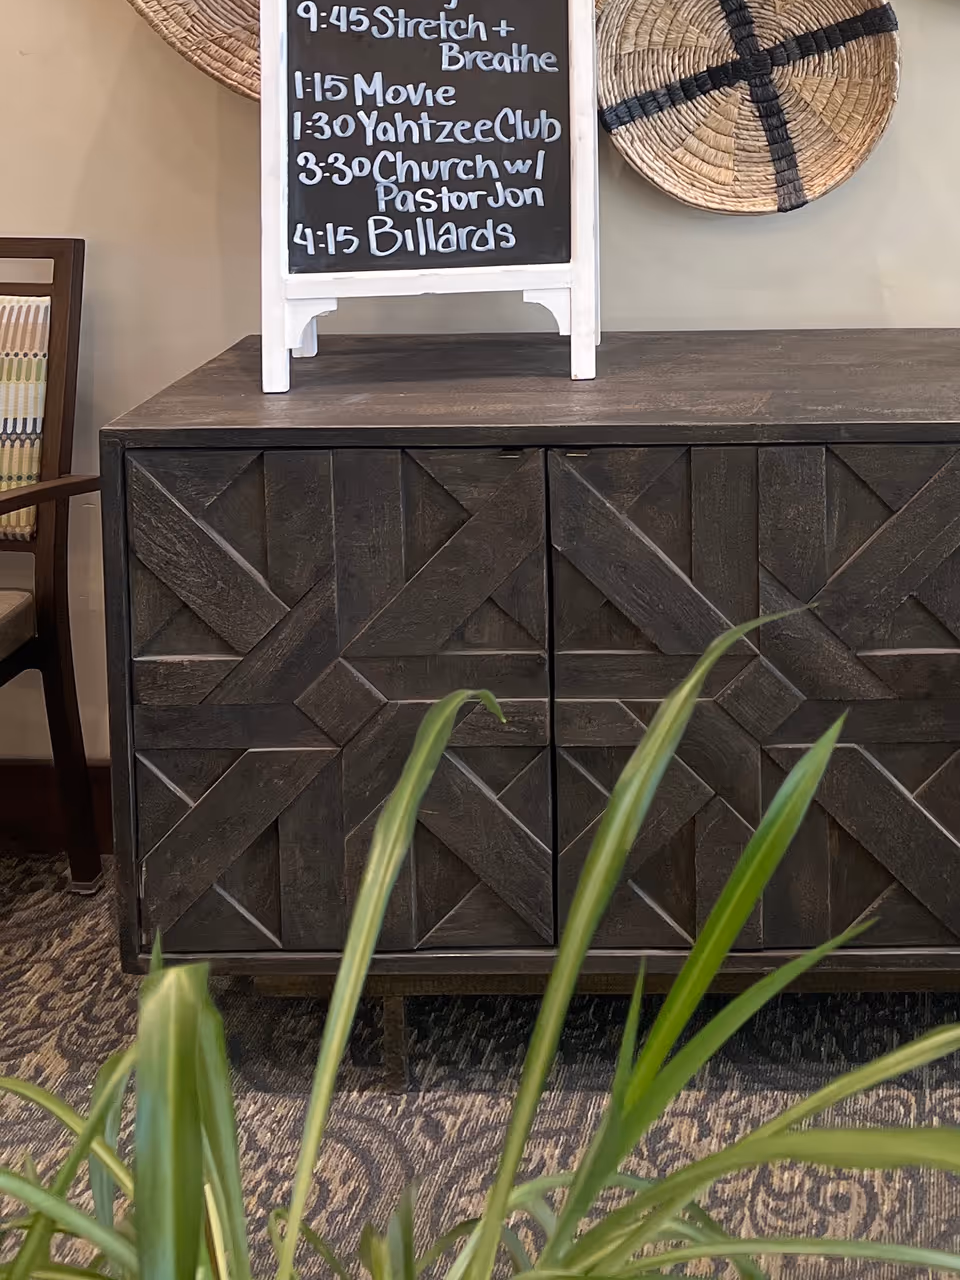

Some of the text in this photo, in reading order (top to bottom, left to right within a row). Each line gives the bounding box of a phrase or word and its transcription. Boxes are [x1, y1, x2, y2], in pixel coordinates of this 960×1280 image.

[296, 1, 370, 33] 9:45
[371, 5, 488, 41] Stretch
[438, 42, 559, 73] Breathe
[294, 71, 456, 107] 1:15 Movie
[293, 107, 562, 146] 1:30 Yahtzee Club
[296, 150, 546, 186] 3:30 Church w/
[375, 181, 545, 214] Pastor Jon
[292, 216, 517, 256] 4:15 Billards
